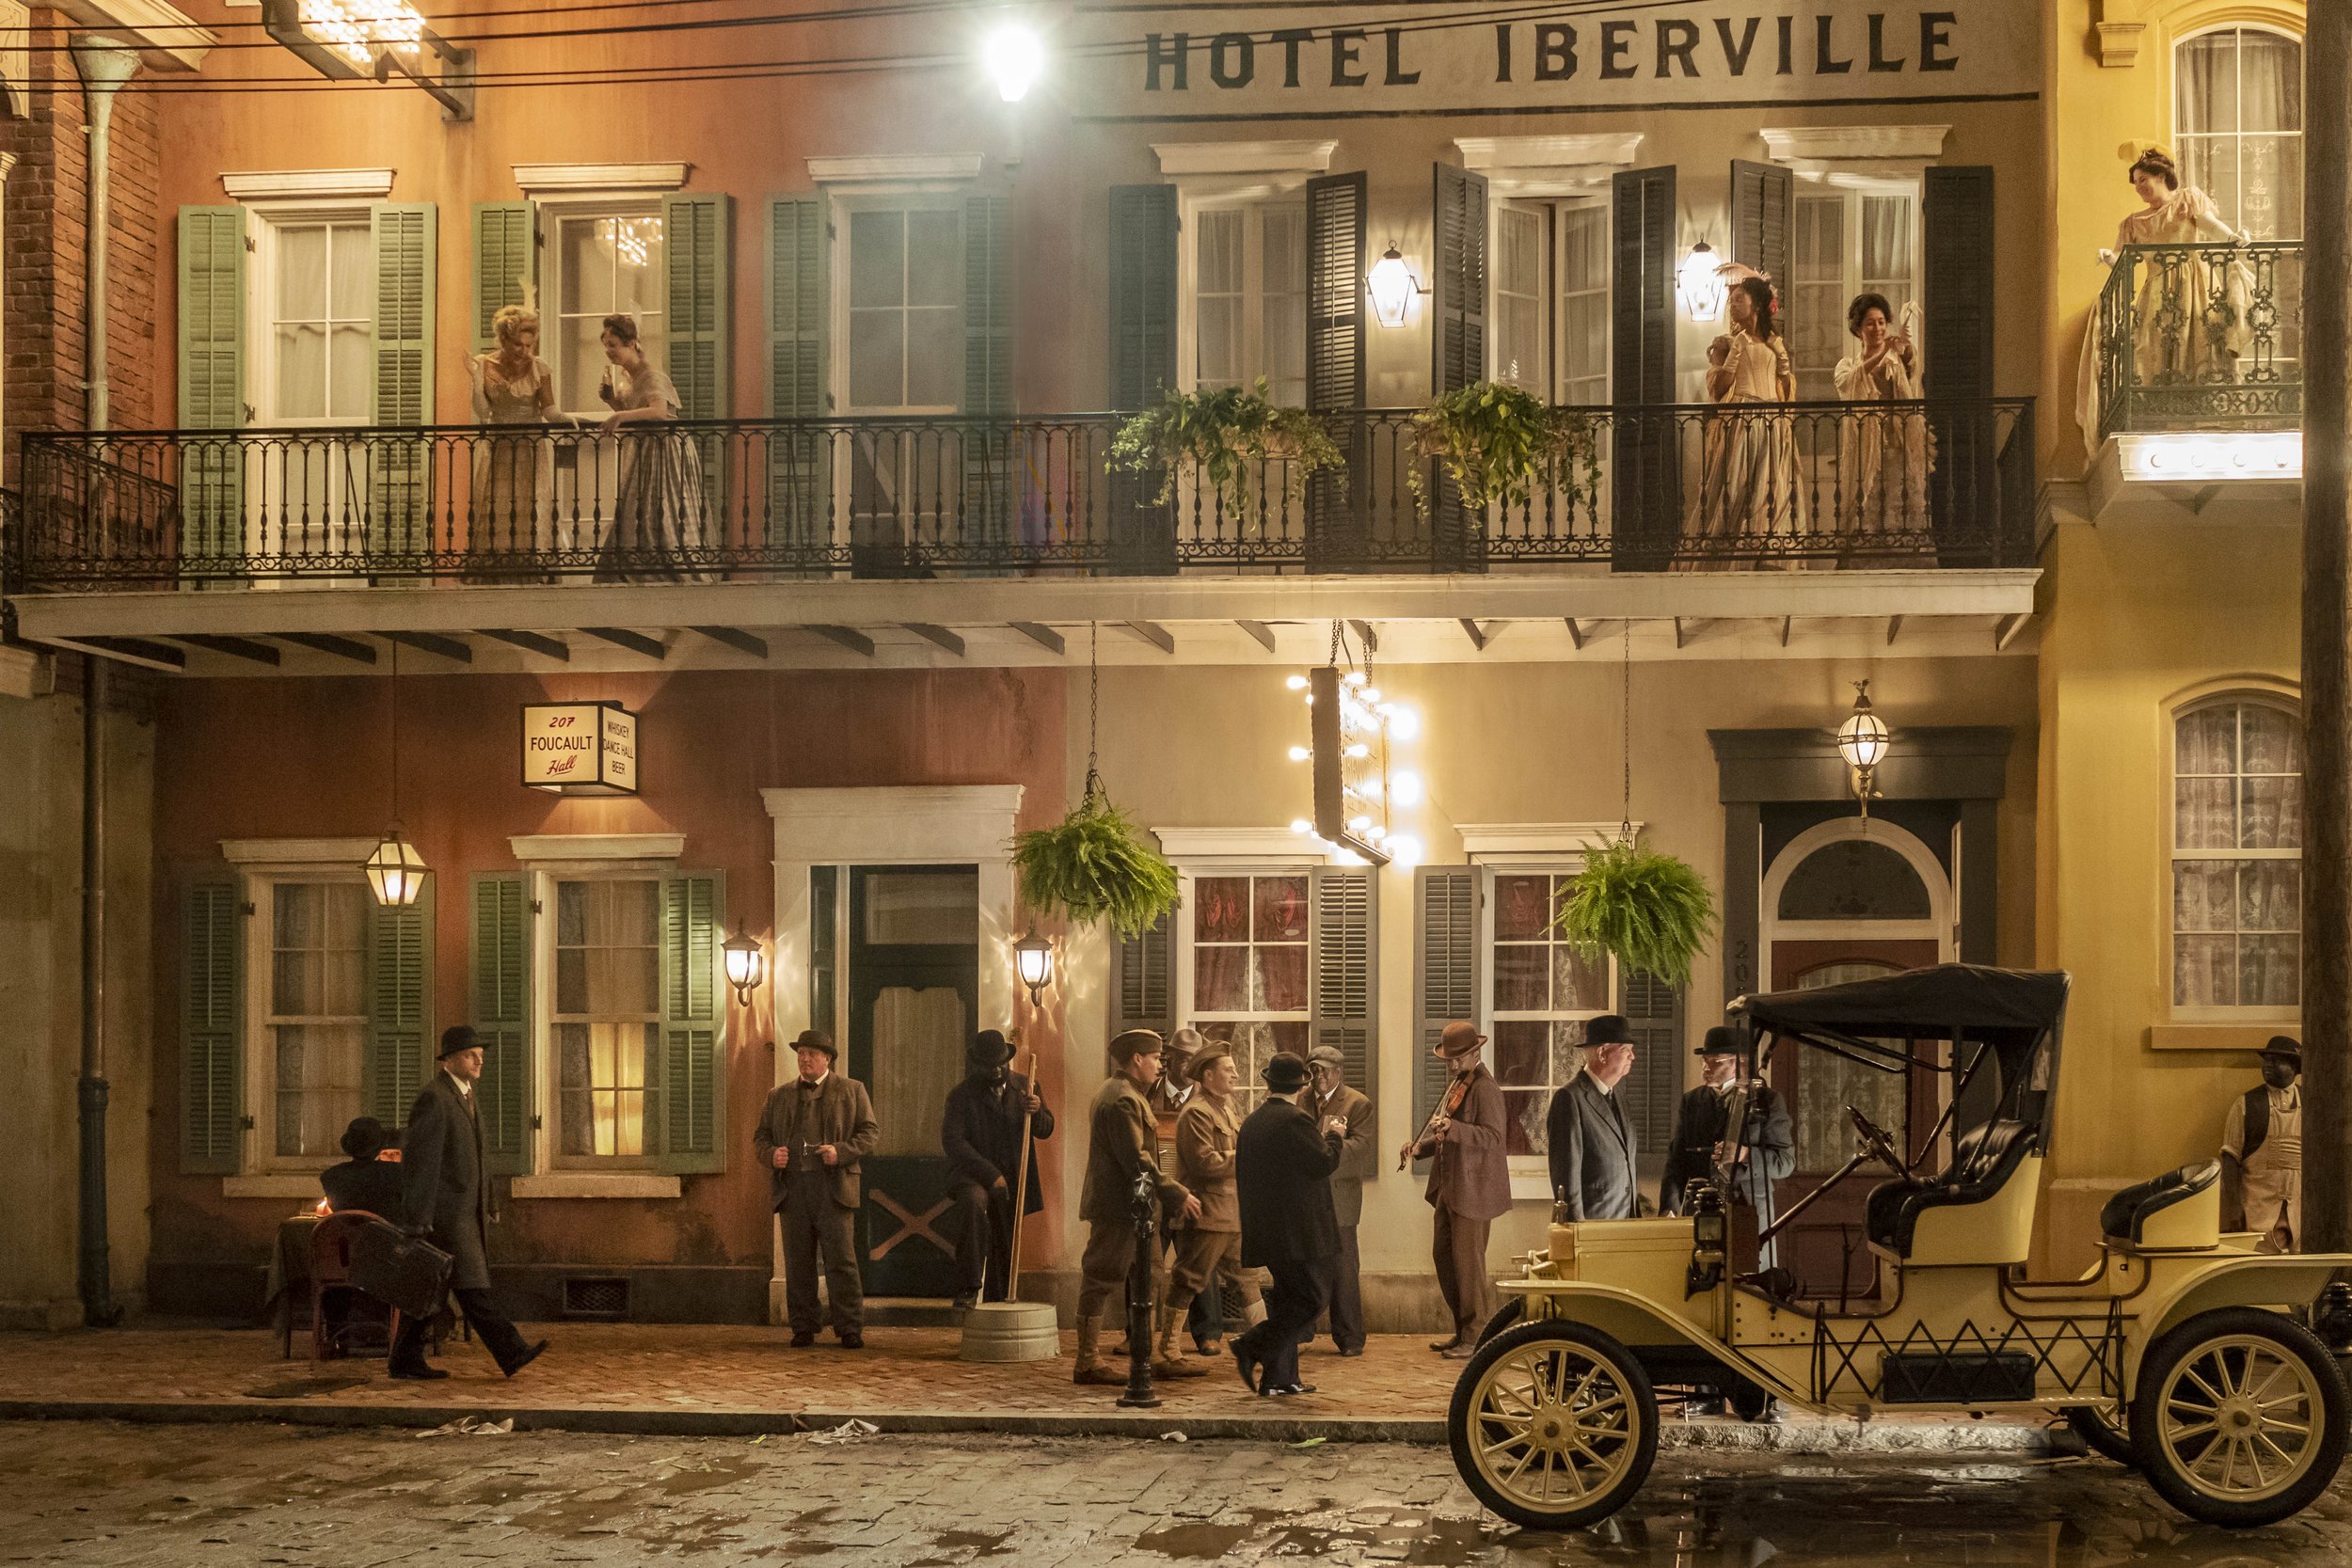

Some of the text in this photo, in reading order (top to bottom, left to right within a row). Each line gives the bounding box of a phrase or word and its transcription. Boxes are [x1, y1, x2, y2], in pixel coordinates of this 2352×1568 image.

[1145, 11, 1960, 91] HOTEL IBERVILLE
[549, 717, 575, 728] 207
[607, 721, 629, 739] WHISKEY
[531, 736, 593, 751] FOUCAULT
[603, 738, 634, 760] DANCE HALL
[547, 754, 578, 775] Hall
[612, 760, 626, 775] BEER
